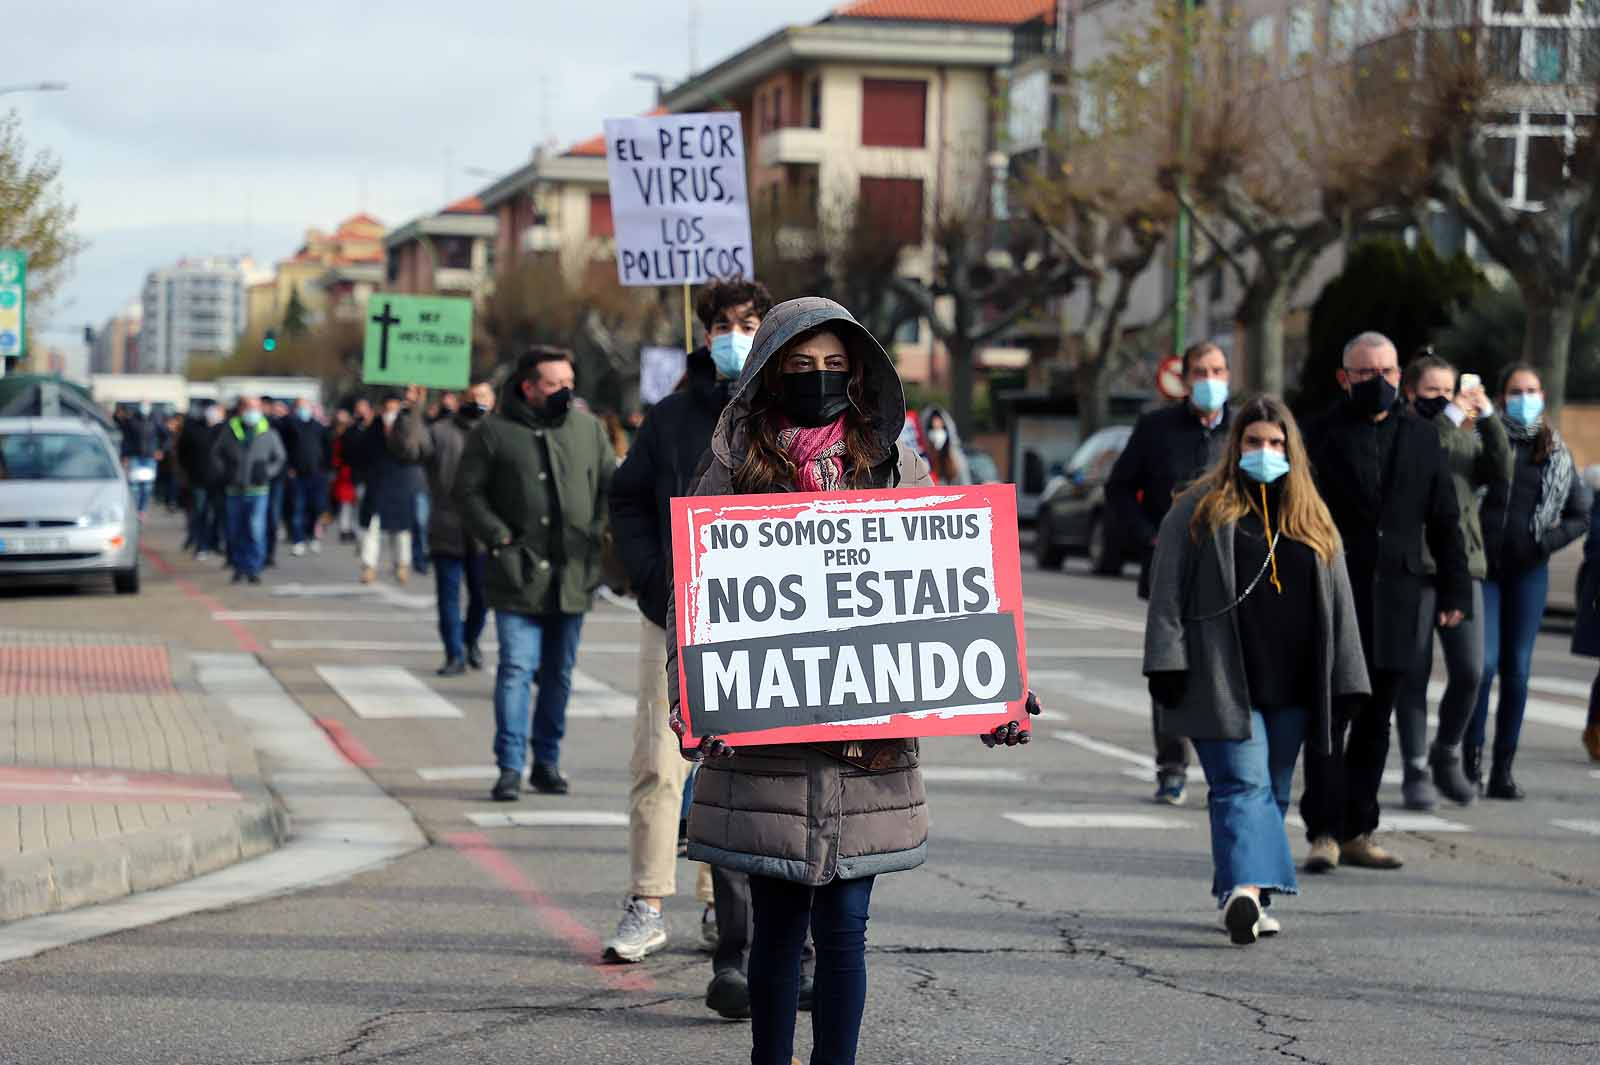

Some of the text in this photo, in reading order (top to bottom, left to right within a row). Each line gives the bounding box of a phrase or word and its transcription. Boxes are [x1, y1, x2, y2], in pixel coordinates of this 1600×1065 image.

[616, 125, 735, 161] EL PEOR
[633, 166, 735, 206] VIRUS,
[662, 217, 704, 245] LOS
[711, 514, 980, 549] NO SOMOS EL VIRUS
[824, 548, 871, 566] PERO
[708, 566, 990, 624] NOS ESTAIS
[702, 638, 1006, 713] MATANDO
